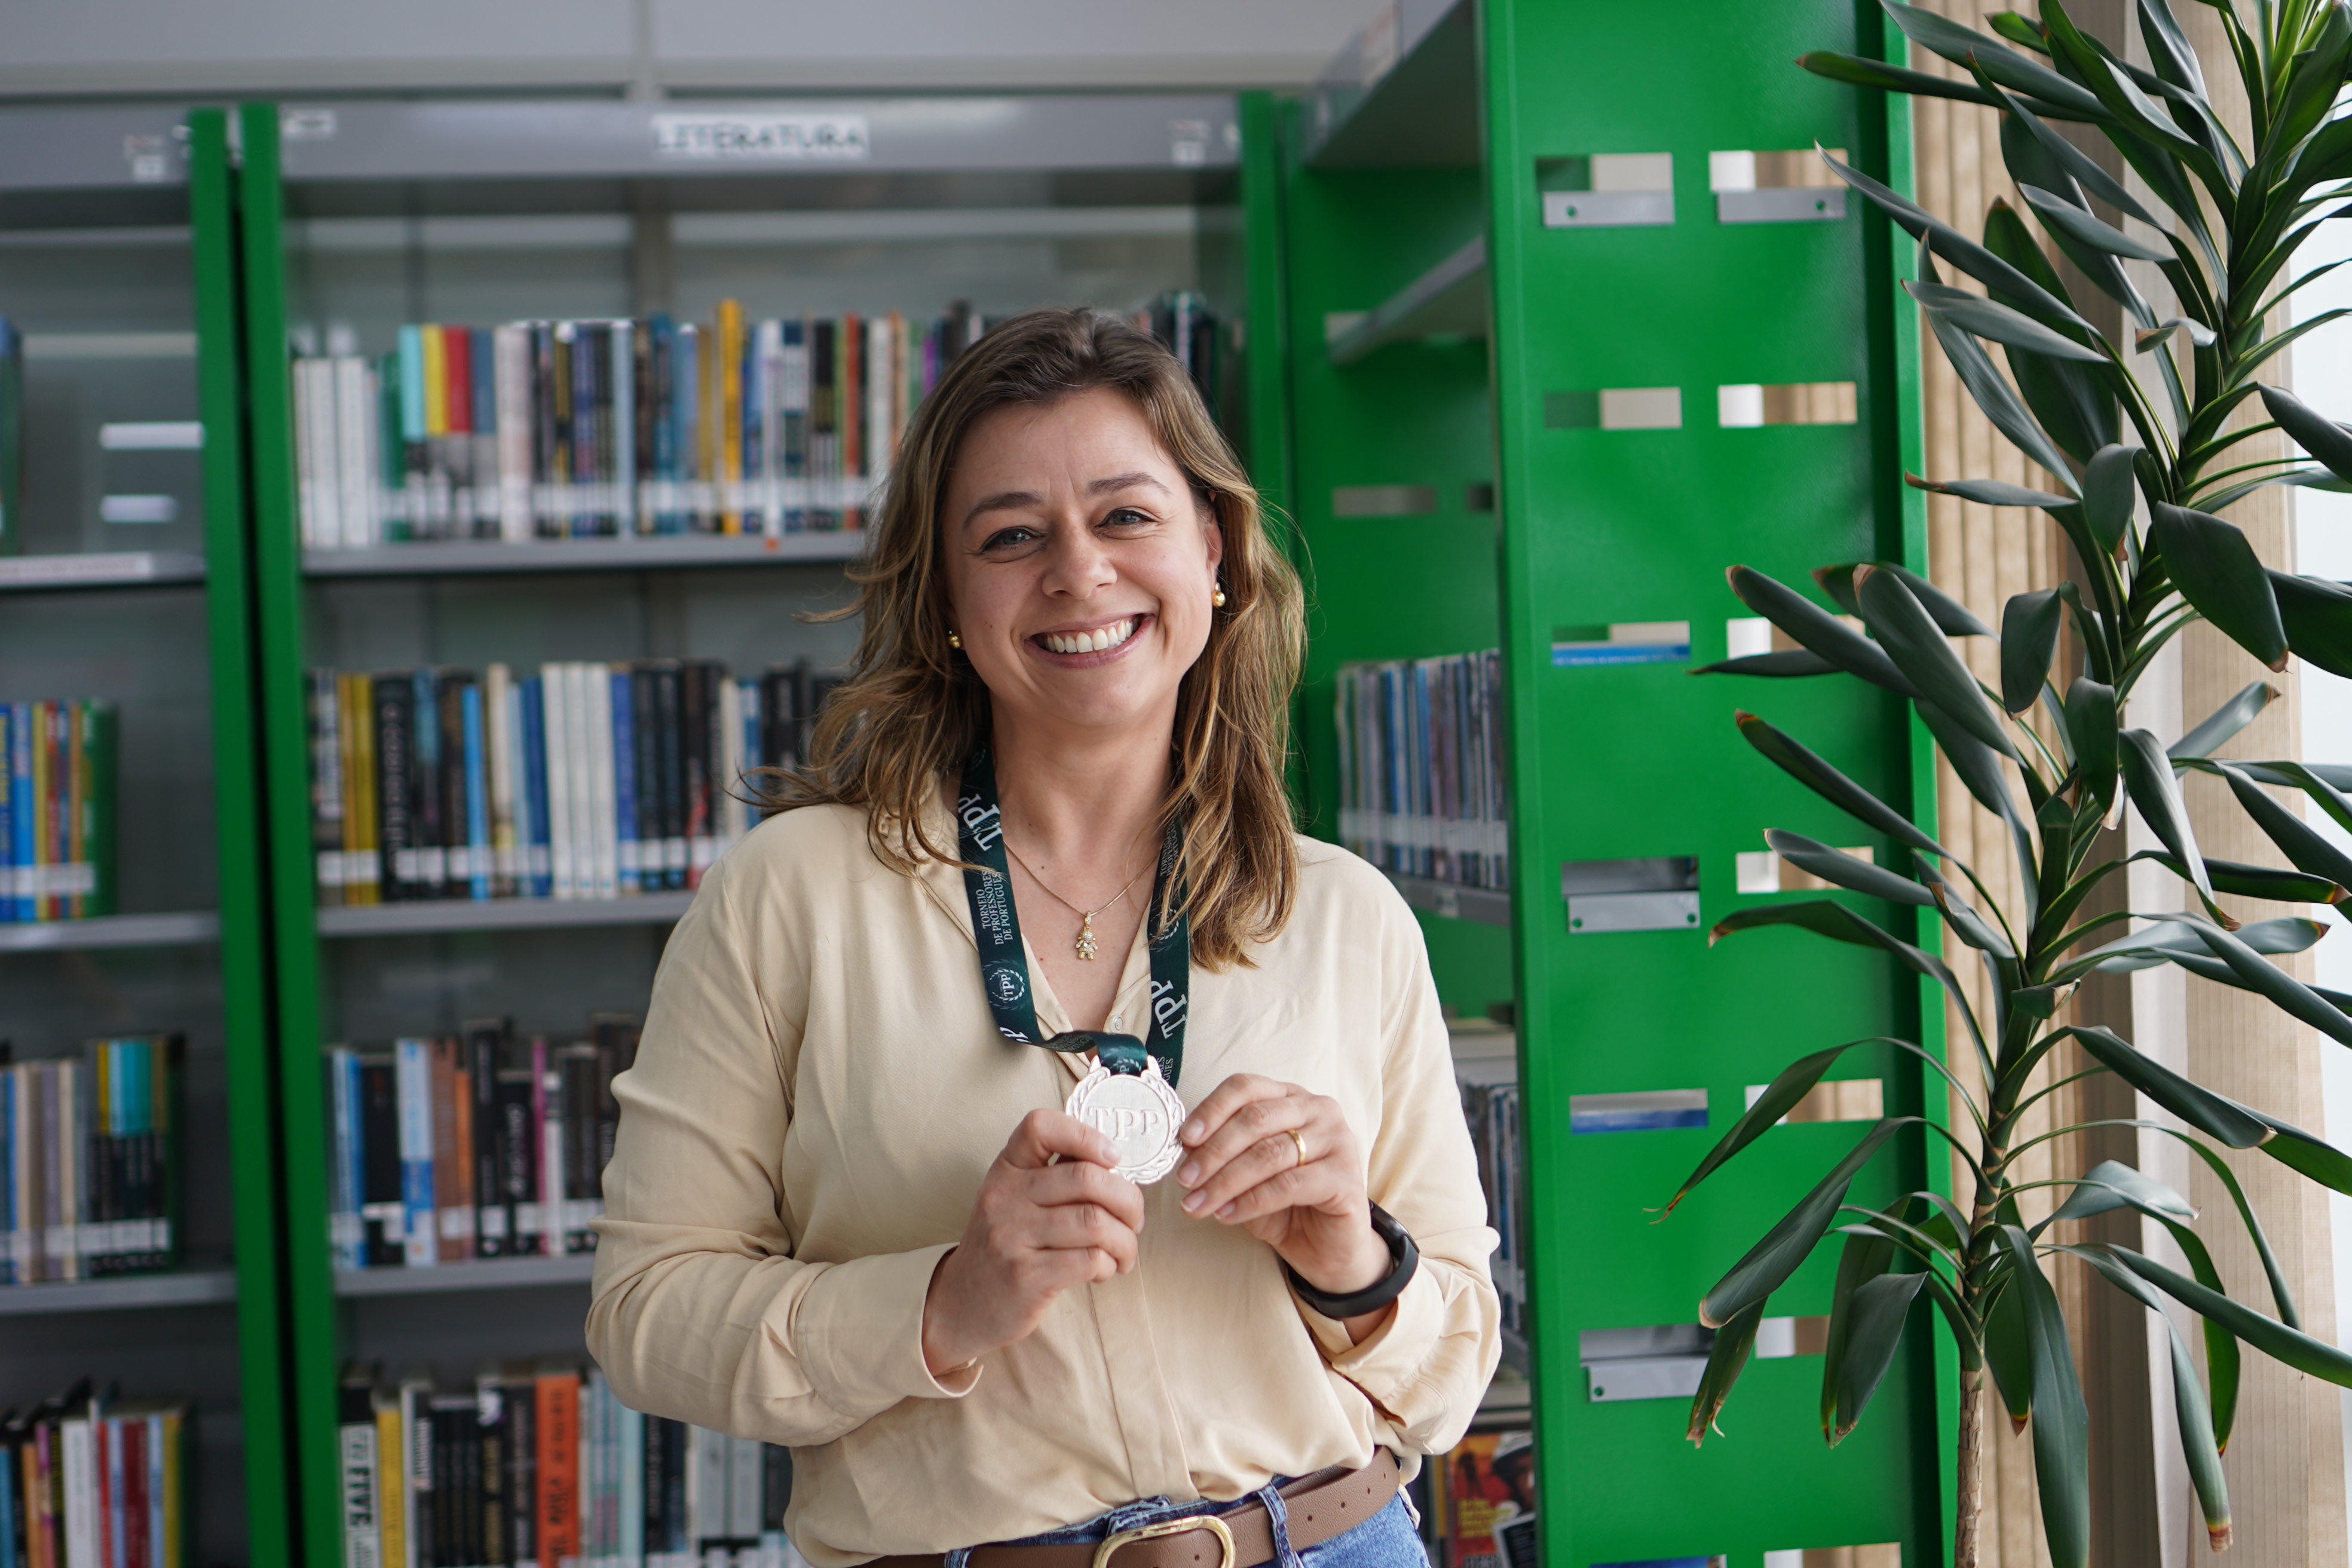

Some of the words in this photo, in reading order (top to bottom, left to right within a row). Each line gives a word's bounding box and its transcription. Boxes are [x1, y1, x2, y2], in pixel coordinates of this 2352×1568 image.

[657, 123, 865, 149] LITERATURA
[957, 793, 1003, 852] TPP
[976, 889, 991, 929] TORNEIO
[982, 871, 1002, 932] PROFESSORES
[993, 933, 1004, 945] DE
[1002, 928, 1013, 941] DE
[1000, 974, 1015, 997] TPP
[1151, 980, 1187, 1039] TPP
[1087, 1106, 1164, 1141] TPP
